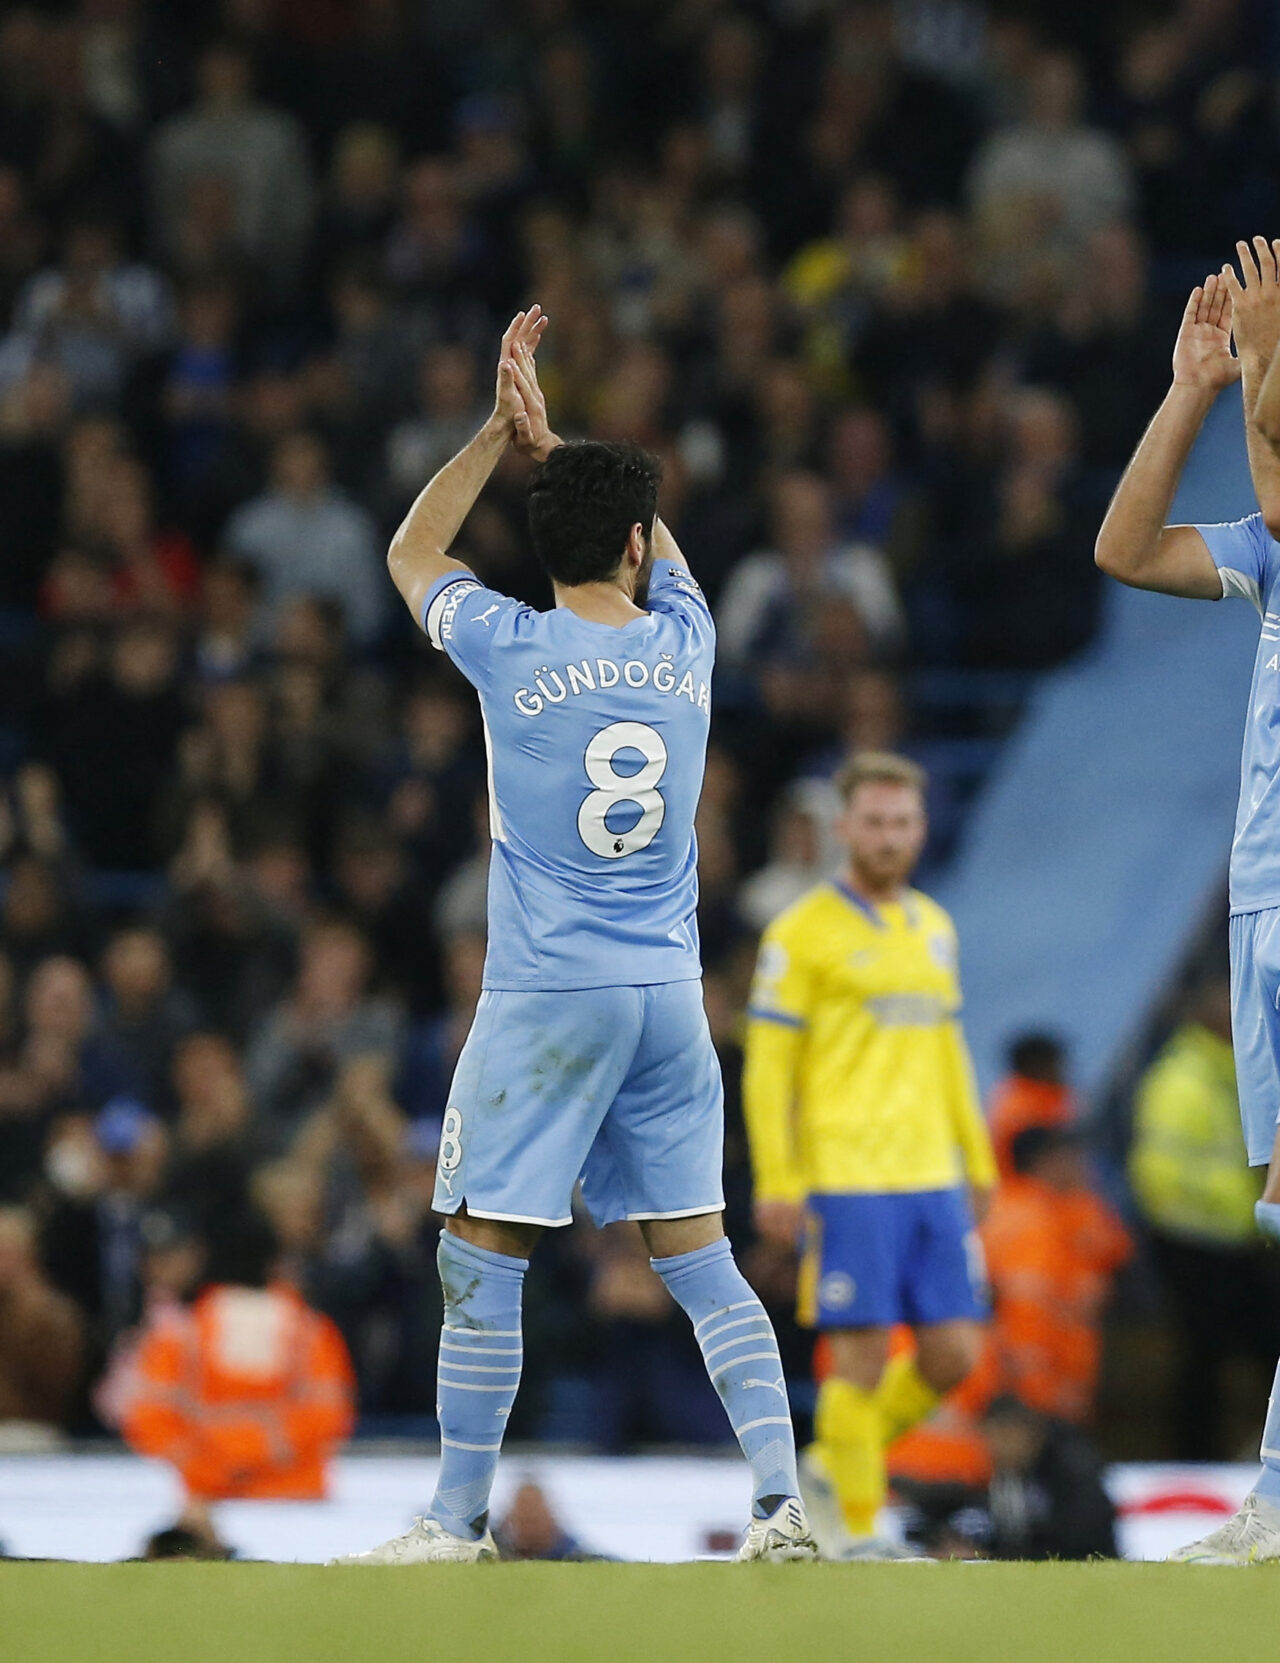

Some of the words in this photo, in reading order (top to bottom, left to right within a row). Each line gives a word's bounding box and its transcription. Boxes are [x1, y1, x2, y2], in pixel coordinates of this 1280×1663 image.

[441, 586, 480, 640] NEXE
[577, 720, 668, 859] 8
[440, 1107, 462, 1170] 8
